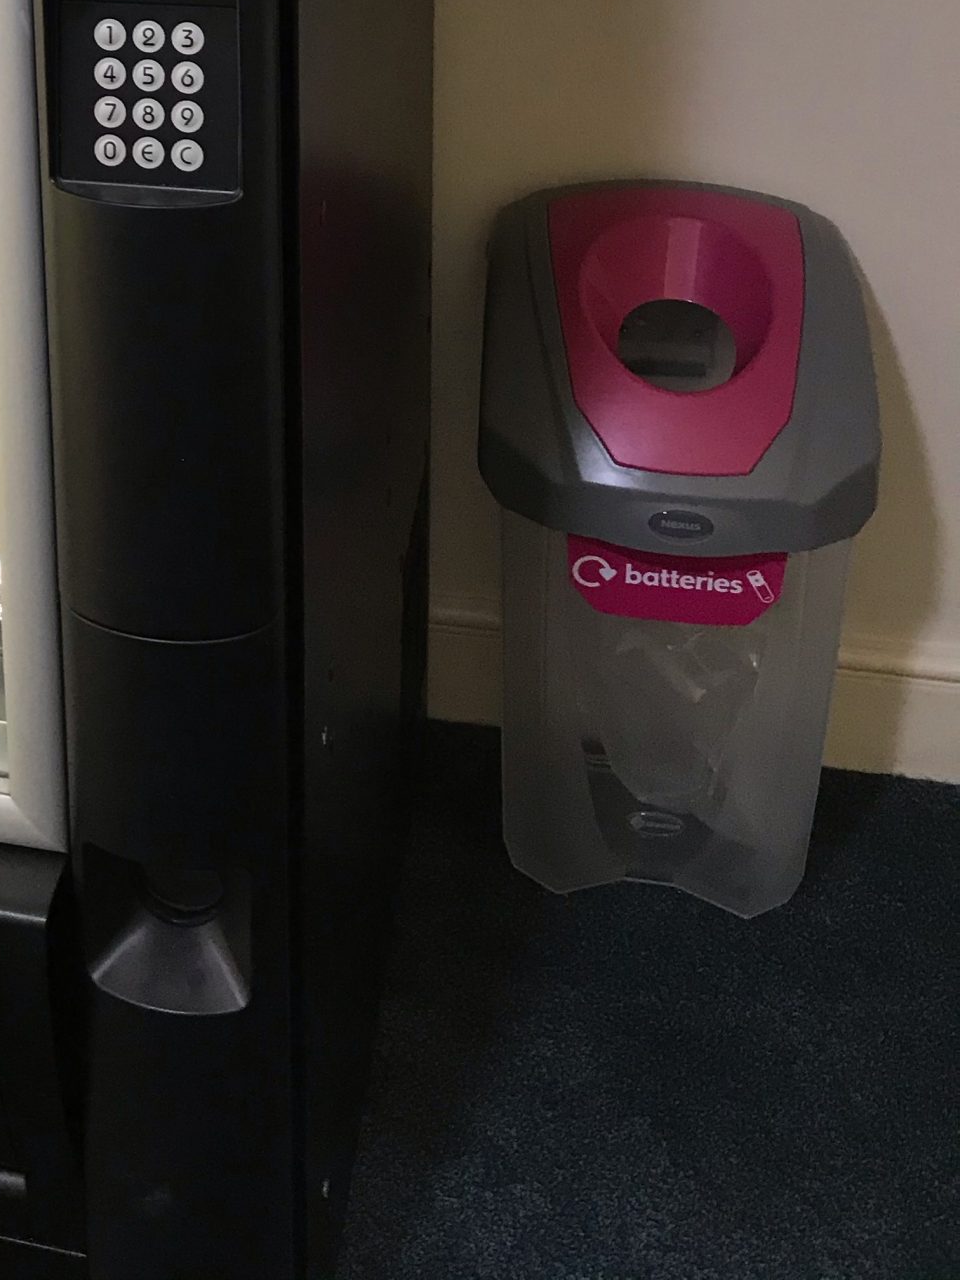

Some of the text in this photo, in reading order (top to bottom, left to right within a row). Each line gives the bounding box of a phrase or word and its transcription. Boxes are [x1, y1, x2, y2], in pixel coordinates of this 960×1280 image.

[142, 27, 155, 46] 2
[181, 29, 194, 48] 3
[103, 64, 194, 87] 4 5 6
[104, 102, 194, 126] 7 8 9
[103, 141, 116, 160] 0
[180, 146, 193, 165] C
[624, 562, 744, 595] batteries
